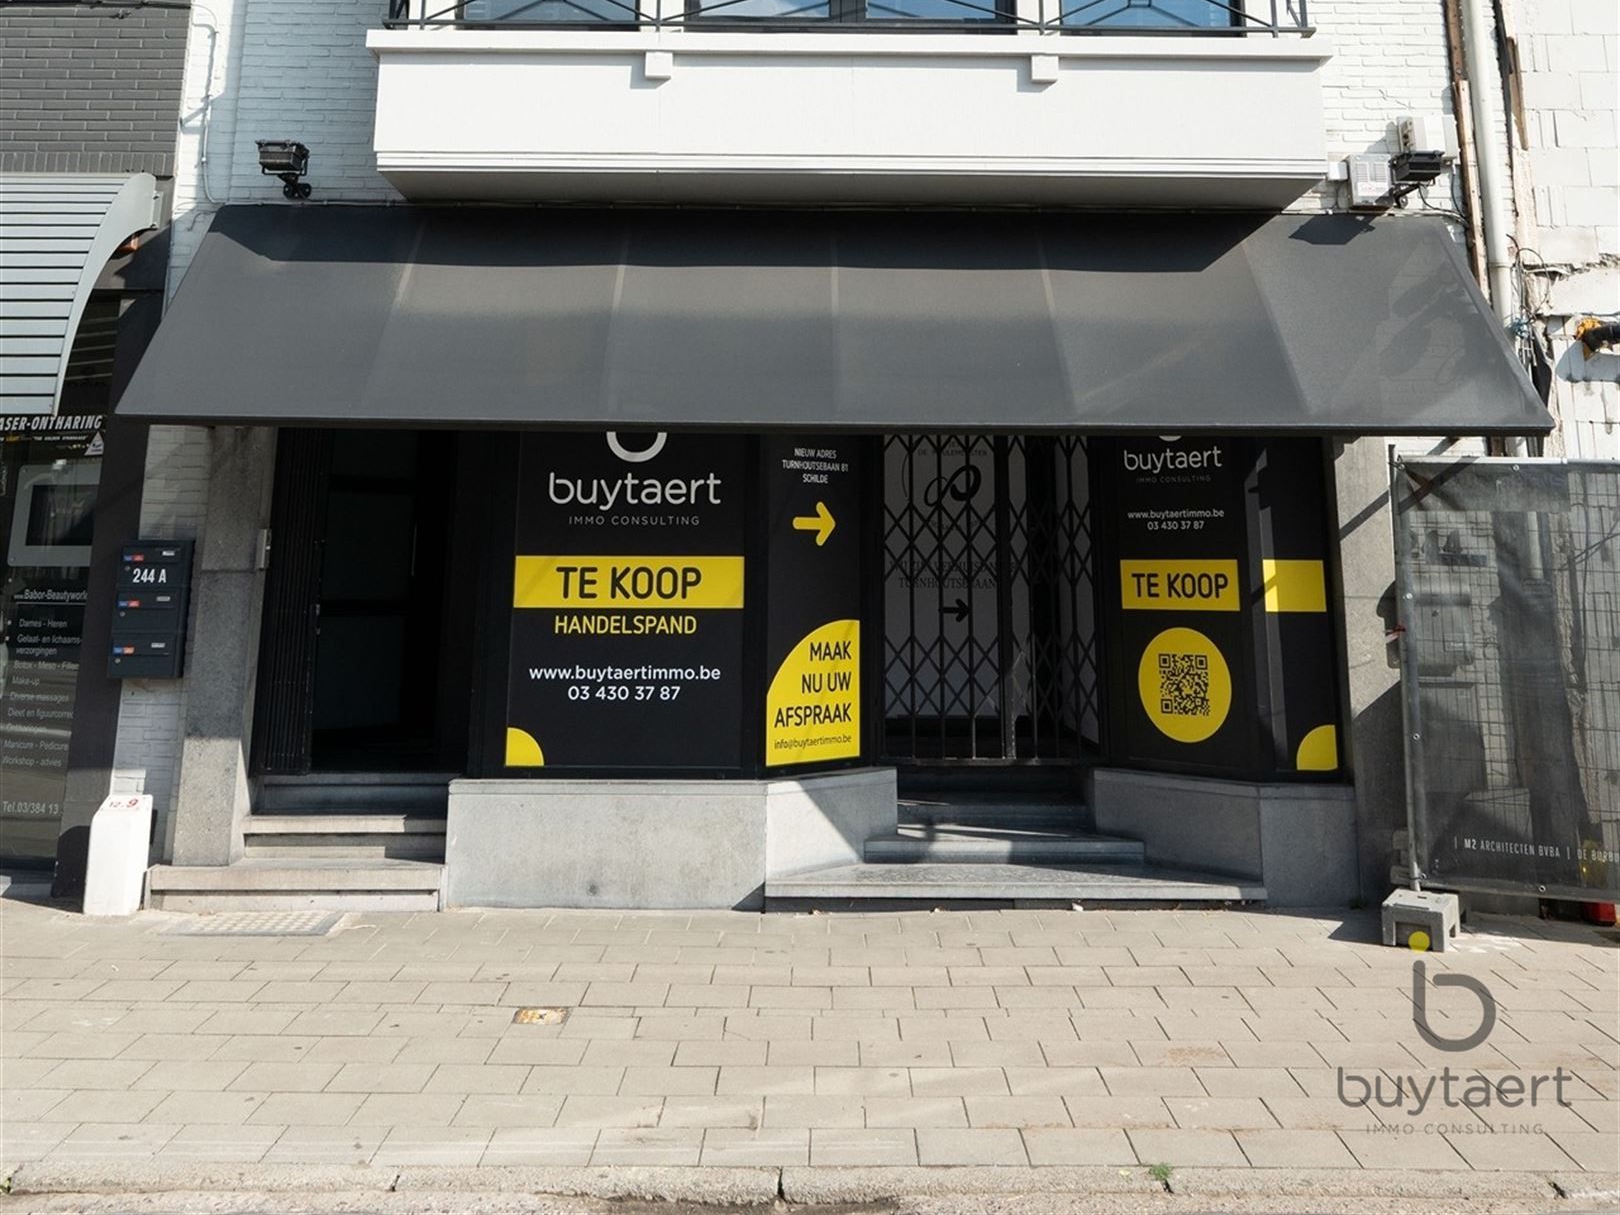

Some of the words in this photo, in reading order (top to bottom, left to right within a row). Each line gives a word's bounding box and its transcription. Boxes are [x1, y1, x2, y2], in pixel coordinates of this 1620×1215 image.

[794, 447, 815, 458] NIEUW
[816, 449, 837, 459] ADRES
[1124, 446, 1222, 474] buytaert
[782, 459, 840, 472] TURNHOUTSEBAAN
[802, 473, 829, 484] SCHILDE
[1159, 474, 1211, 483] CONSULTING
[549, 472, 721, 511] buytaert
[568, 516, 605, 526] IMMO
[611, 516, 700, 526] CONSULTING
[1127, 508, 1225, 521] www.buytaertimmo.be
[1147, 521, 1158, 530] 03
[1161, 521, 1179, 530] 430
[1181, 521, 1192, 530] 37
[1193, 521, 1205, 530] 87
[132, 568, 156, 584] 244
[158, 568, 168, 584] A
[556, 567, 598, 599] TE
[611, 567, 702, 599] KOOP
[1131, 573, 1159, 598] TE
[1167, 573, 1228, 598] KOOP
[555, 616, 697, 635] HANDELSPAND
[810, 641, 851, 662] MAAK
[529, 665, 721, 682] www.buytaertimmo.be
[801, 672, 823, 694] NU
[827, 671, 851, 693] UW
[568, 686, 590, 700] 03
[595, 686, 629, 700] 430
[634, 686, 656, 700] 37
[659, 686, 680, 700] 87
[774, 703, 851, 728] AFSPRAAK
[774, 733, 851, 749] info@buytaertimmo.be
[1464, 838, 1477, 850] M2
[1480, 840, 1535, 856] ARCHITECTEN
[1538, 844, 1561, 858] BVBA
[1577, 848, 1588, 861] DE
